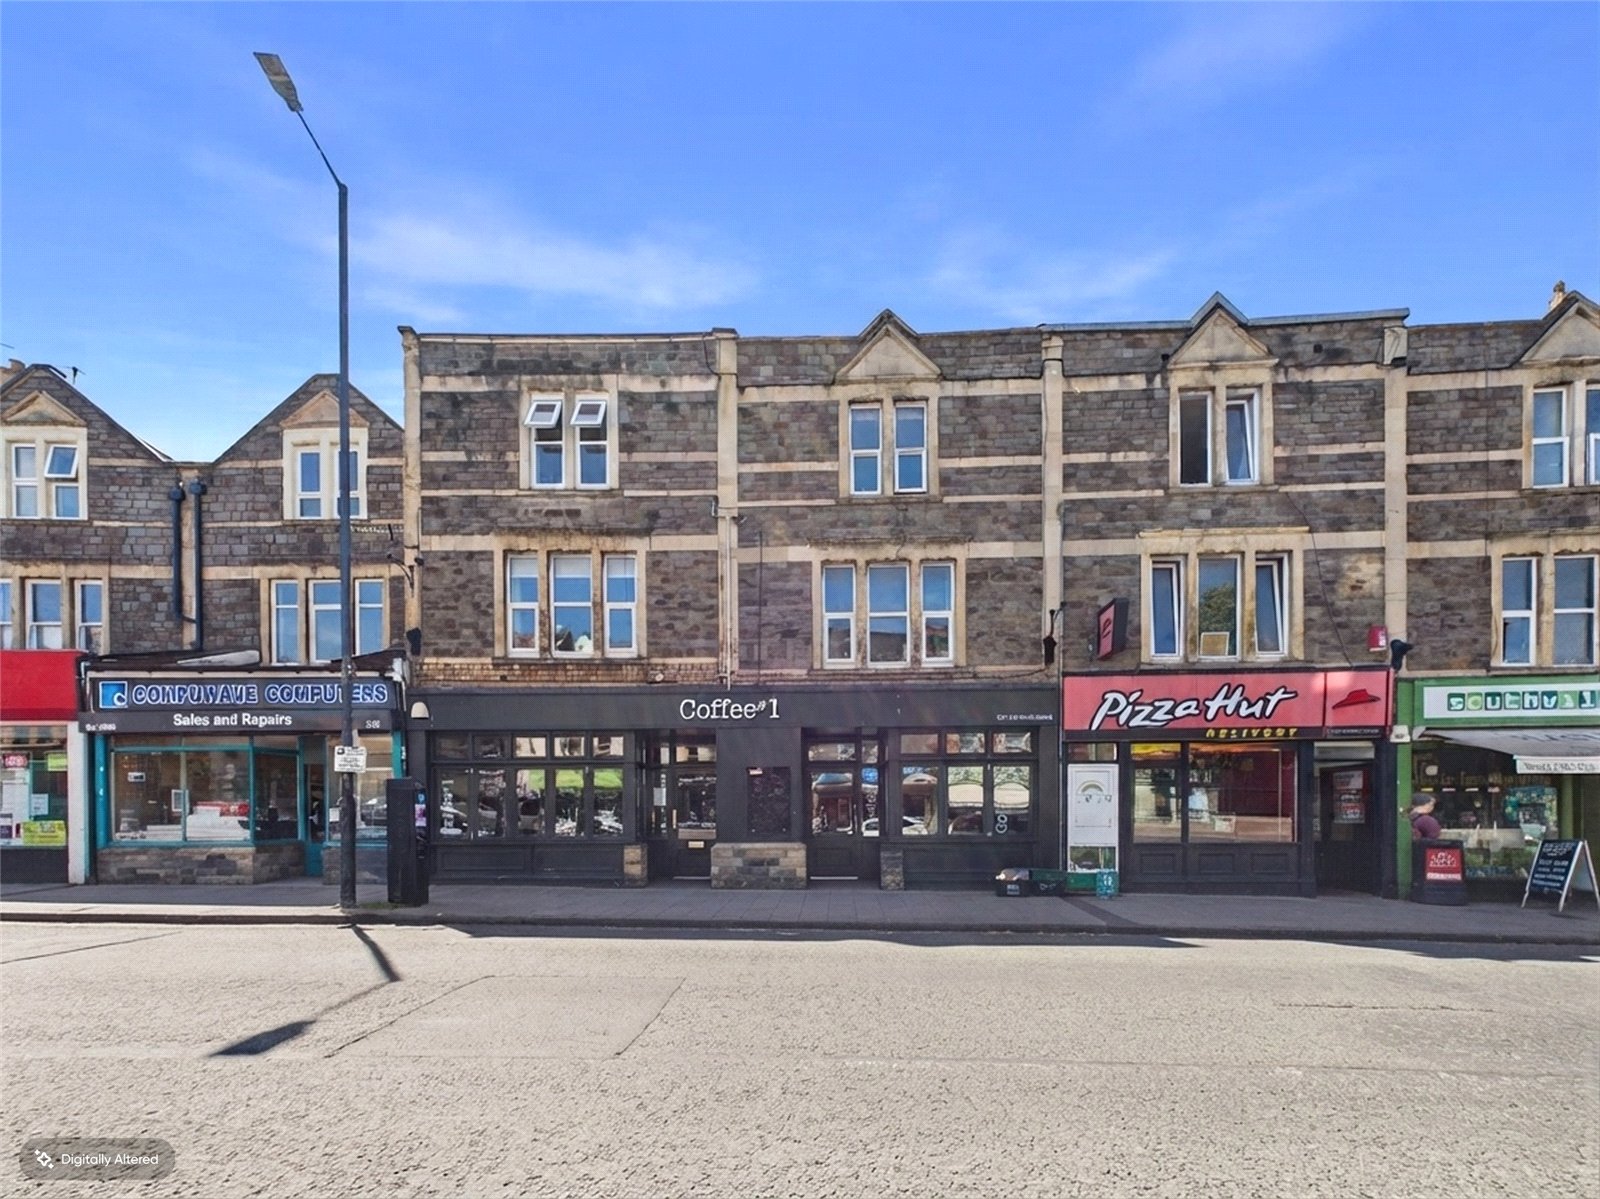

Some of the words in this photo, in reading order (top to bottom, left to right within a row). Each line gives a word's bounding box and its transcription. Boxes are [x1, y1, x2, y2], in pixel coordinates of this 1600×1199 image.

[172, 713, 210, 726] Sales
[213, 713, 238, 726] and
[1090, 689, 1201, 730] Pizza
[1203, 683, 1298, 721] Hut
